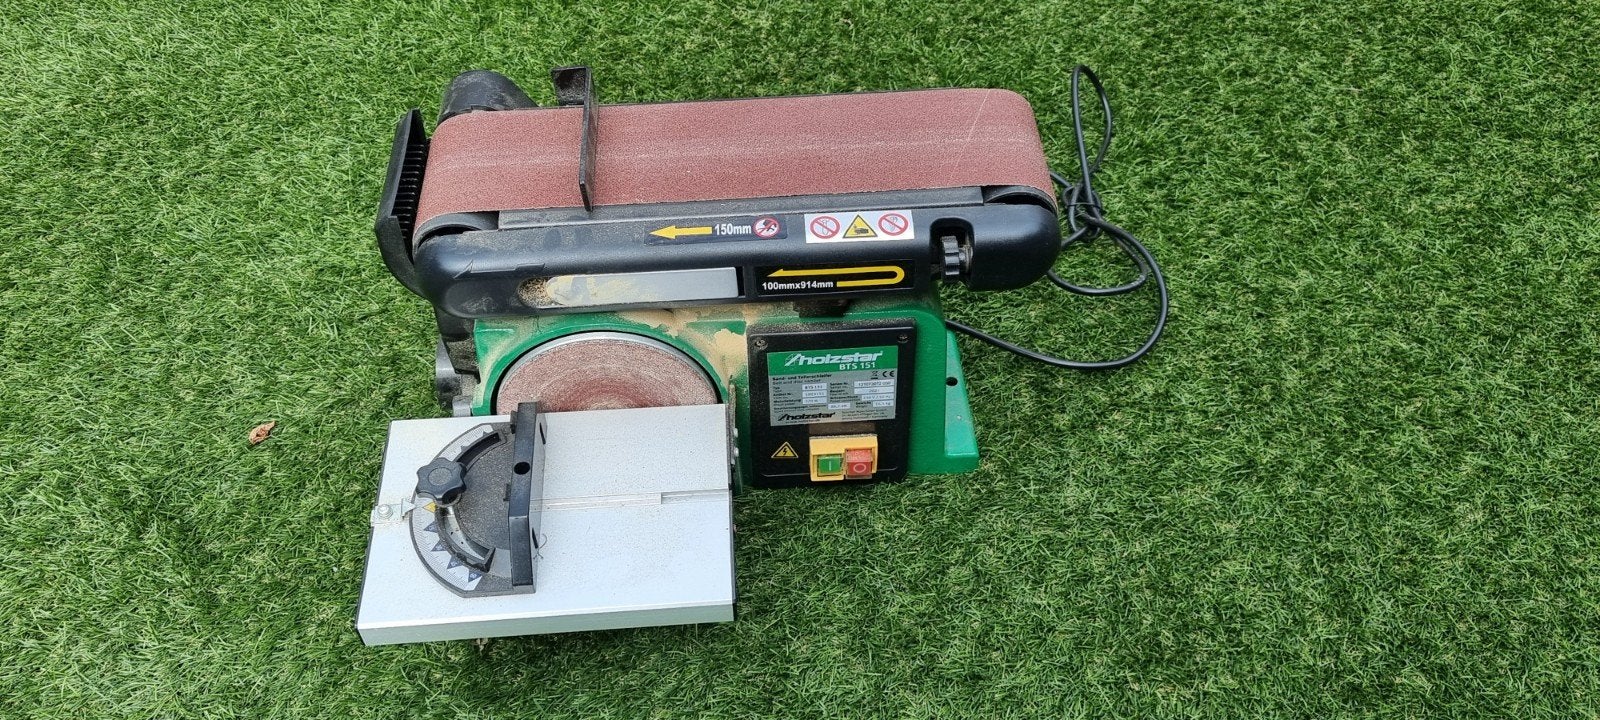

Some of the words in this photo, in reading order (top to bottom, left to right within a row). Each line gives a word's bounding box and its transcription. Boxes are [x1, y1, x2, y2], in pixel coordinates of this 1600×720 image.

[714, 223, 752, 236] 150mm
[762, 280, 834, 290] 100mmx914mm
[798, 351, 883, 366] holzstar
[840, 363, 858, 371] BTS
[861, 361, 876, 369] 151
[786, 412, 836, 421] holzstar
